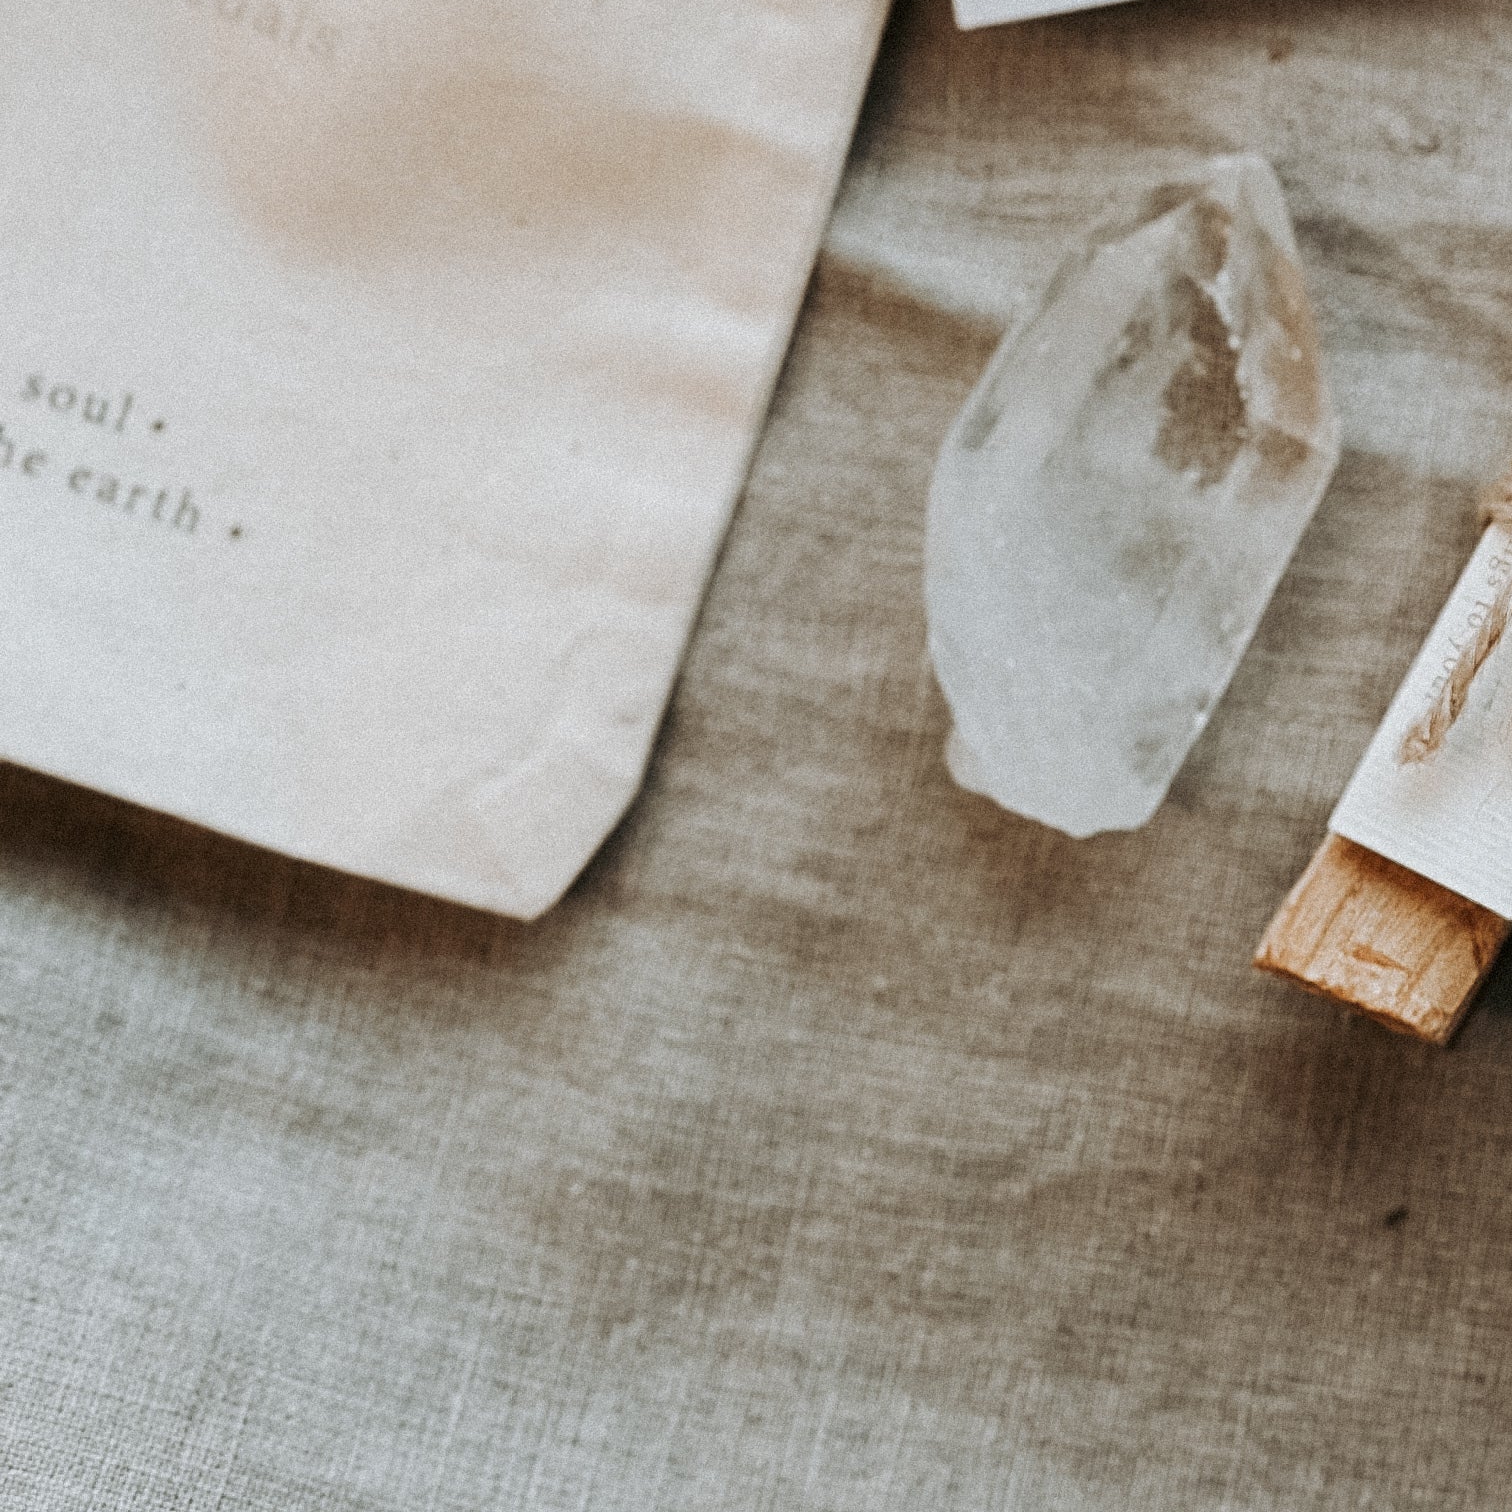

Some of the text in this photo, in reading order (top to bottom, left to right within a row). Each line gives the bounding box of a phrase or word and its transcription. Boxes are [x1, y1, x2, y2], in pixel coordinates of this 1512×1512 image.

[20, 372, 134, 434] soul
[0, 421, 202, 535] he earth
